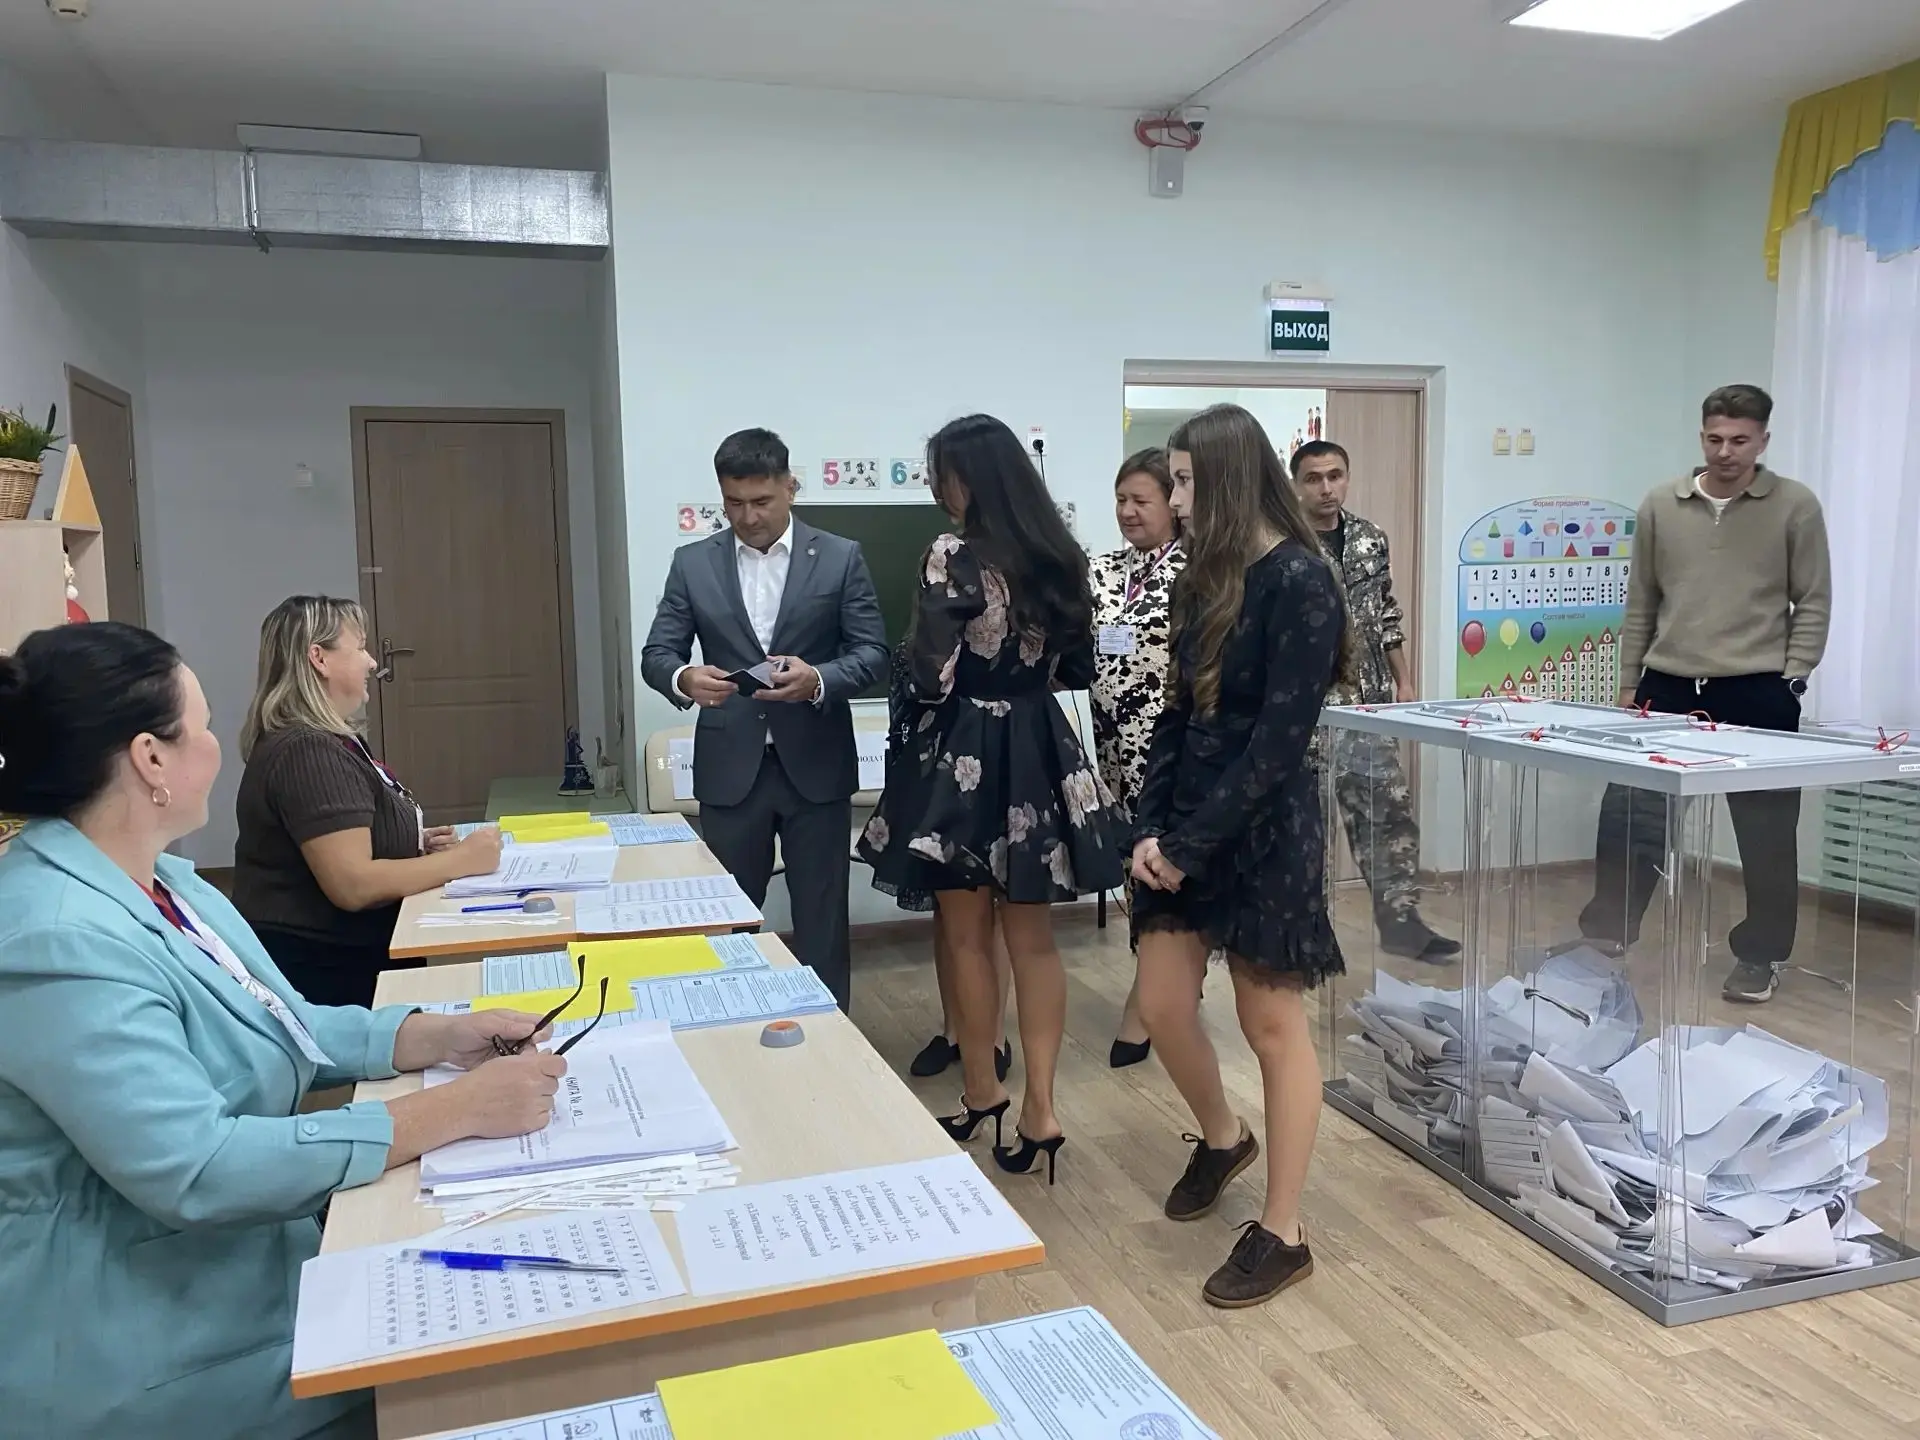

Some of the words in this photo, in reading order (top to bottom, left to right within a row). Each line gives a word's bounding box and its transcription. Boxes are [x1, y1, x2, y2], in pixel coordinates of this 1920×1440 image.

[1274, 323, 1328, 341] ВЫХОД
[823, 462, 839, 486] 5
[891, 462, 907, 486] 6
[679, 507, 696, 531] 3
[1474, 570, 1478, 580] 1
[1492, 570, 1498, 580] 2
[1511, 569, 1517, 579] 3
[1530, 568, 1536, 578] 4
[1549, 568, 1555, 578] 5
[1568, 567, 1573, 577] 6
[1586, 567, 1592, 577] 7
[1604, 566, 1610, 576] 8
[1623, 566, 1628, 575] 9
